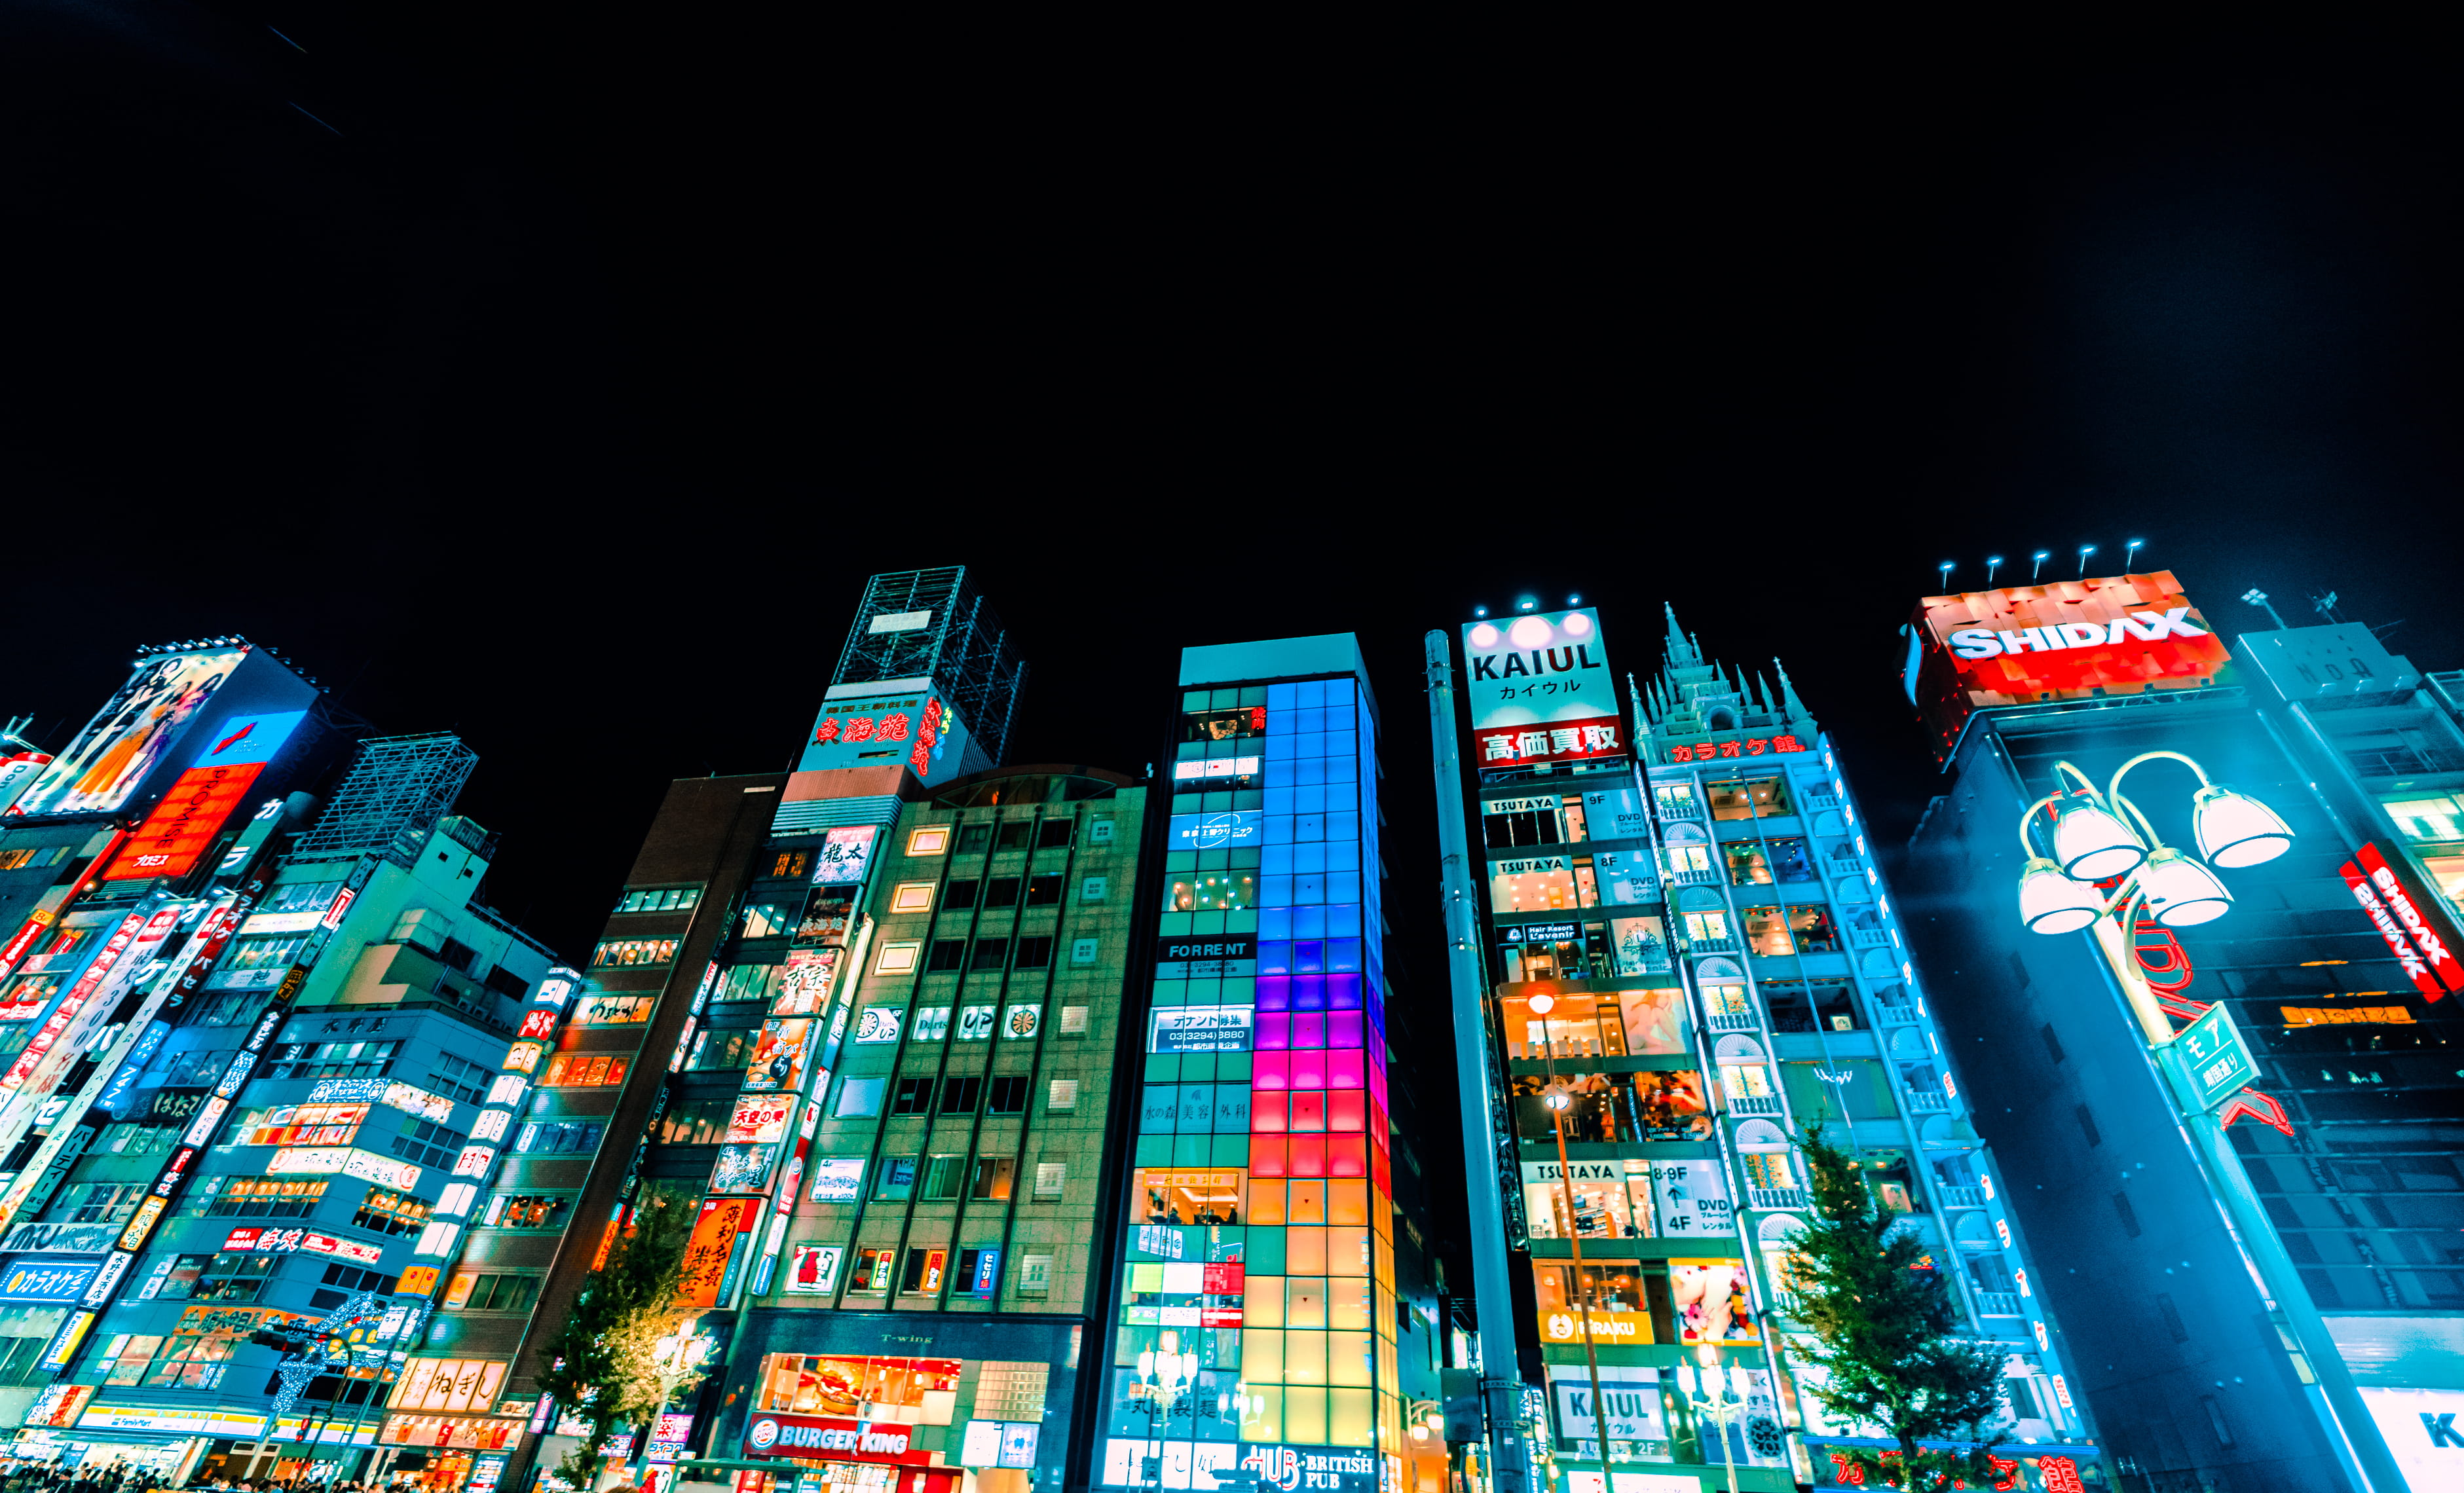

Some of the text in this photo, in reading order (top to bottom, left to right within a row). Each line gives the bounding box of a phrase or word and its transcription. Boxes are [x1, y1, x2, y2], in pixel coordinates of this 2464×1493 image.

[1949, 607, 2208, 659] SHIDAX
[1472, 644, 1601, 682] KAIUL
[1500, 679, 1580, 699] カイウル
[812, 712, 910, 745] 東海苑
[1483, 725, 1619, 761] 高価買取
[1671, 735, 1799, 763] カラオケ館
[157, 769, 227, 848] PROMISE
[1493, 798, 1554, 811] TSUTAYA
[1589, 795, 1605, 805] 9F
[1618, 813, 1640, 822] DVD
[829, 832, 842, 841] 9F
[823, 843, 865, 863] 龍太
[1601, 857, 1617, 867] 8F
[1501, 859, 1563, 872] TSUTAYA
[1631, 876, 1654, 885] DVD
[2373, 866, 2450, 967] SHIDAX
[2353, 882, 2427, 980] SHIDAX
[1169, 943, 1246, 957] FOR RENT
[920, 1020, 948, 1031] Darts
[965, 1013, 993, 1030] UP
[880, 1028, 895, 1039] UP
[2185, 1018, 2220, 1059] モア
[2202, 1052, 2239, 1089] 靖国通り
[106, 1067, 137, 1099] 747
[1698, 1200, 1728, 1210] DVD
[1670, 1216, 1690, 1229] 4F
[18, 1270, 90, 1295] カラオケ 747
[48, 1315, 82, 1359] FamilyMart
[882, 1334, 933, 1344] T-wing
[430, 1370, 495, 1399] ねぎし
[121, 1418, 152, 1427] FamilyMart
[756, 1431, 774, 1439] KING
[779, 1426, 908, 1454] BURGER KING
[1638, 1443, 1655, 1454] 2F
[1241, 1445, 1299, 1491] HUB
[1305, 1454, 1374, 1473] BRITISH
[1305, 1473, 1340, 1489] PUB
